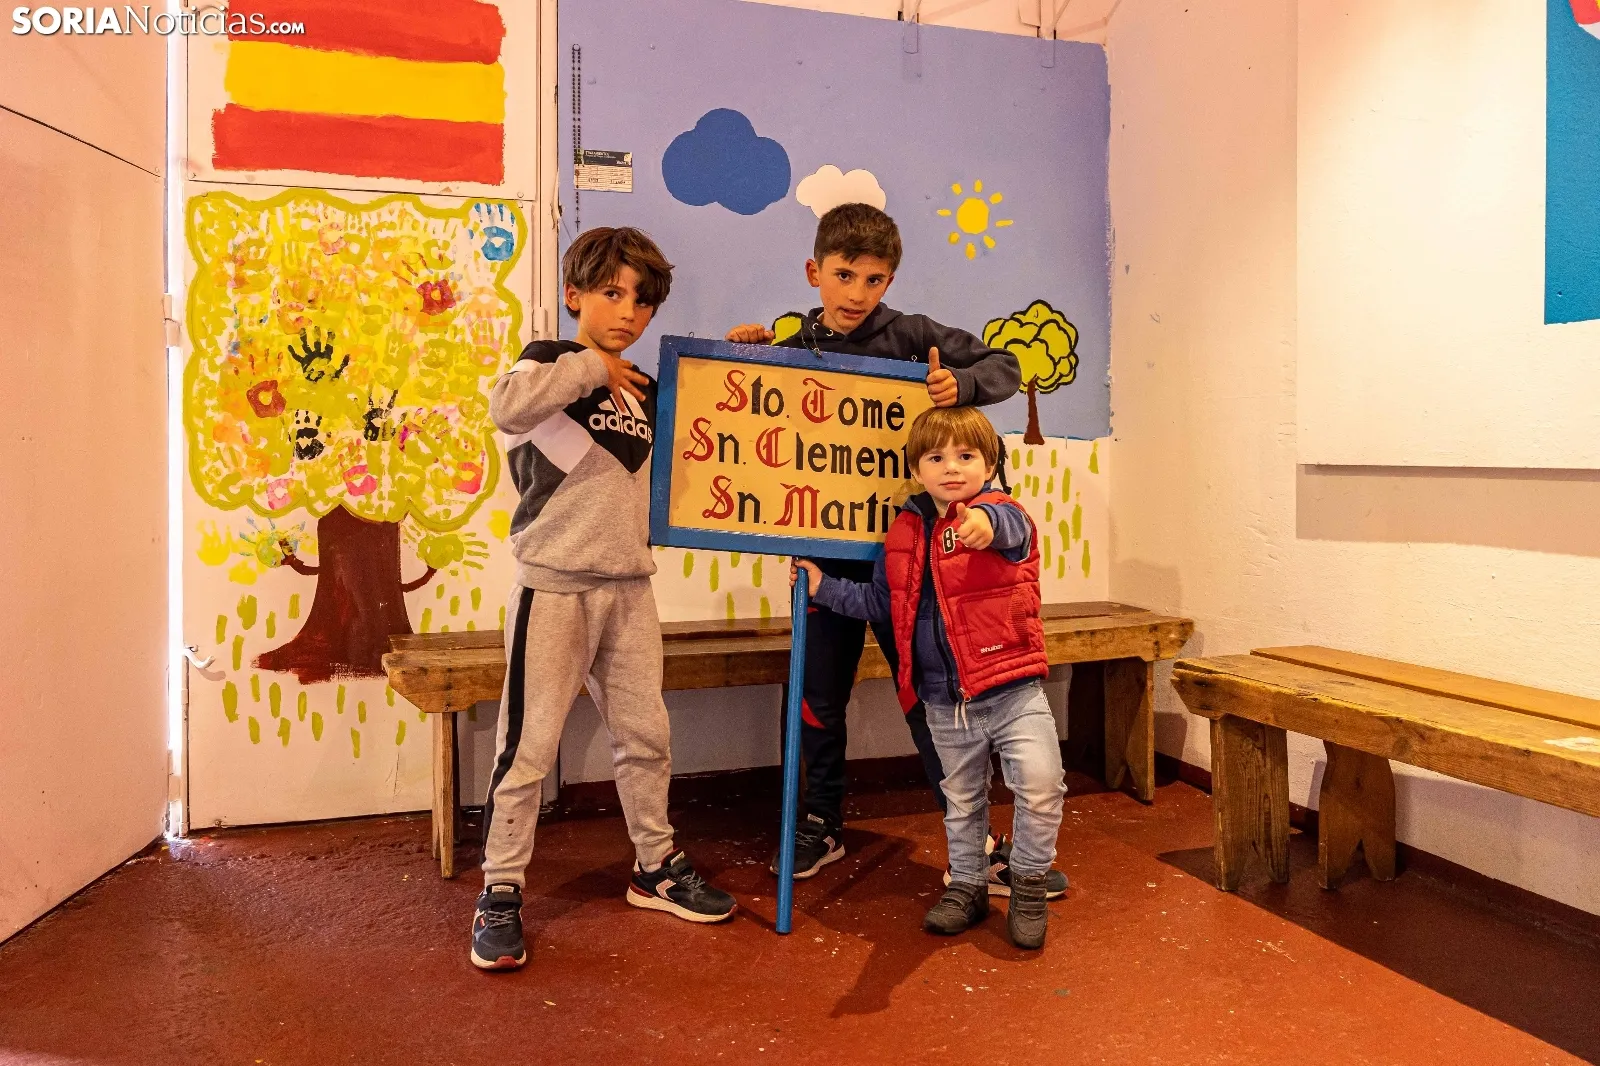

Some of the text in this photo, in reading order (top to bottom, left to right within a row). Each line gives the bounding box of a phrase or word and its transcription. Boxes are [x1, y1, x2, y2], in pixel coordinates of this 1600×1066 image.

[715, 369, 906, 431] Sto. Tomé
[588, 411, 653, 444] adidas
[682, 417, 747, 466] Sn.
[702, 475, 902, 534] Sn. Martí
